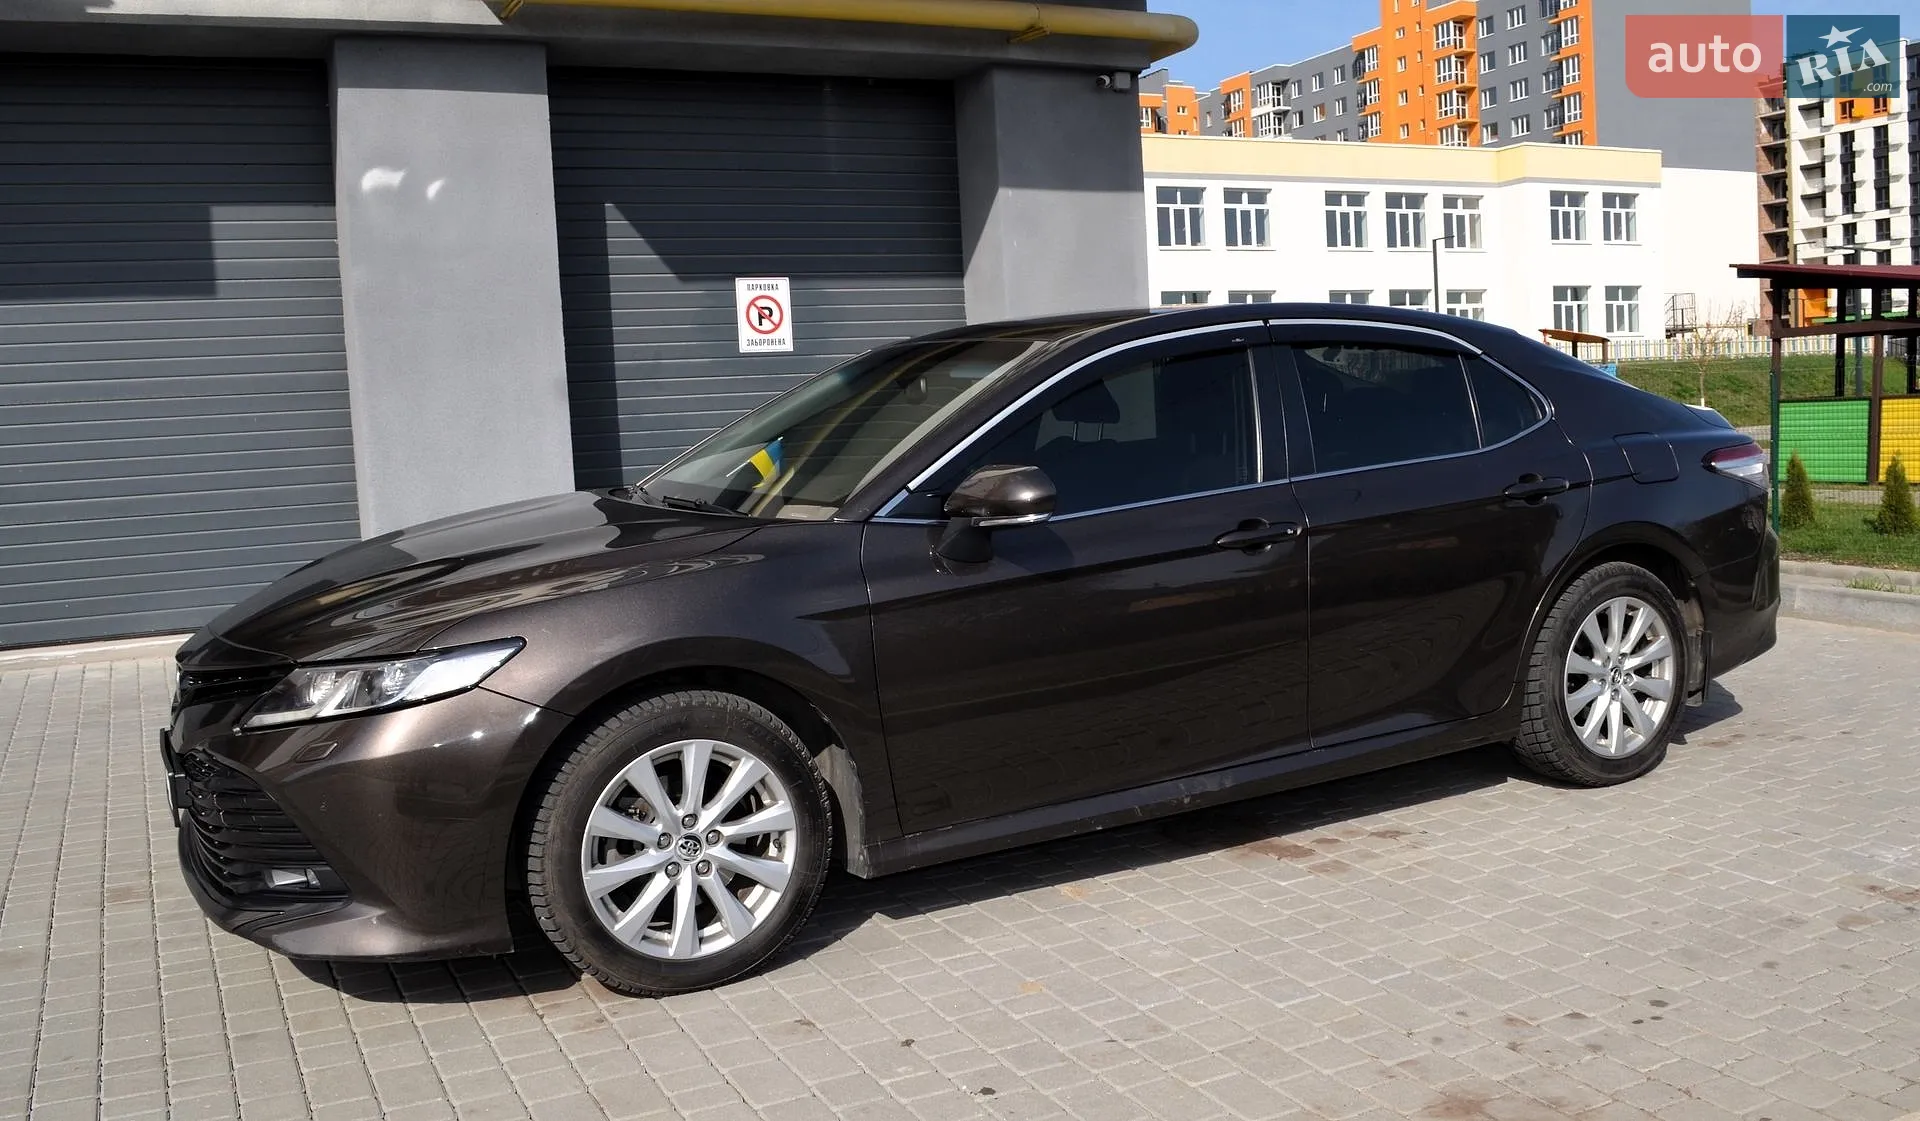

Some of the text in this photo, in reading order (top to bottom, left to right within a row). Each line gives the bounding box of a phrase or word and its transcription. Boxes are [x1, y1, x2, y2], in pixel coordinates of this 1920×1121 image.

[746, 283, 779, 292] ПАРКОВКА
[757, 306, 774, 326] P
[746, 338, 787, 347] ЗАБОРОНЕНА
